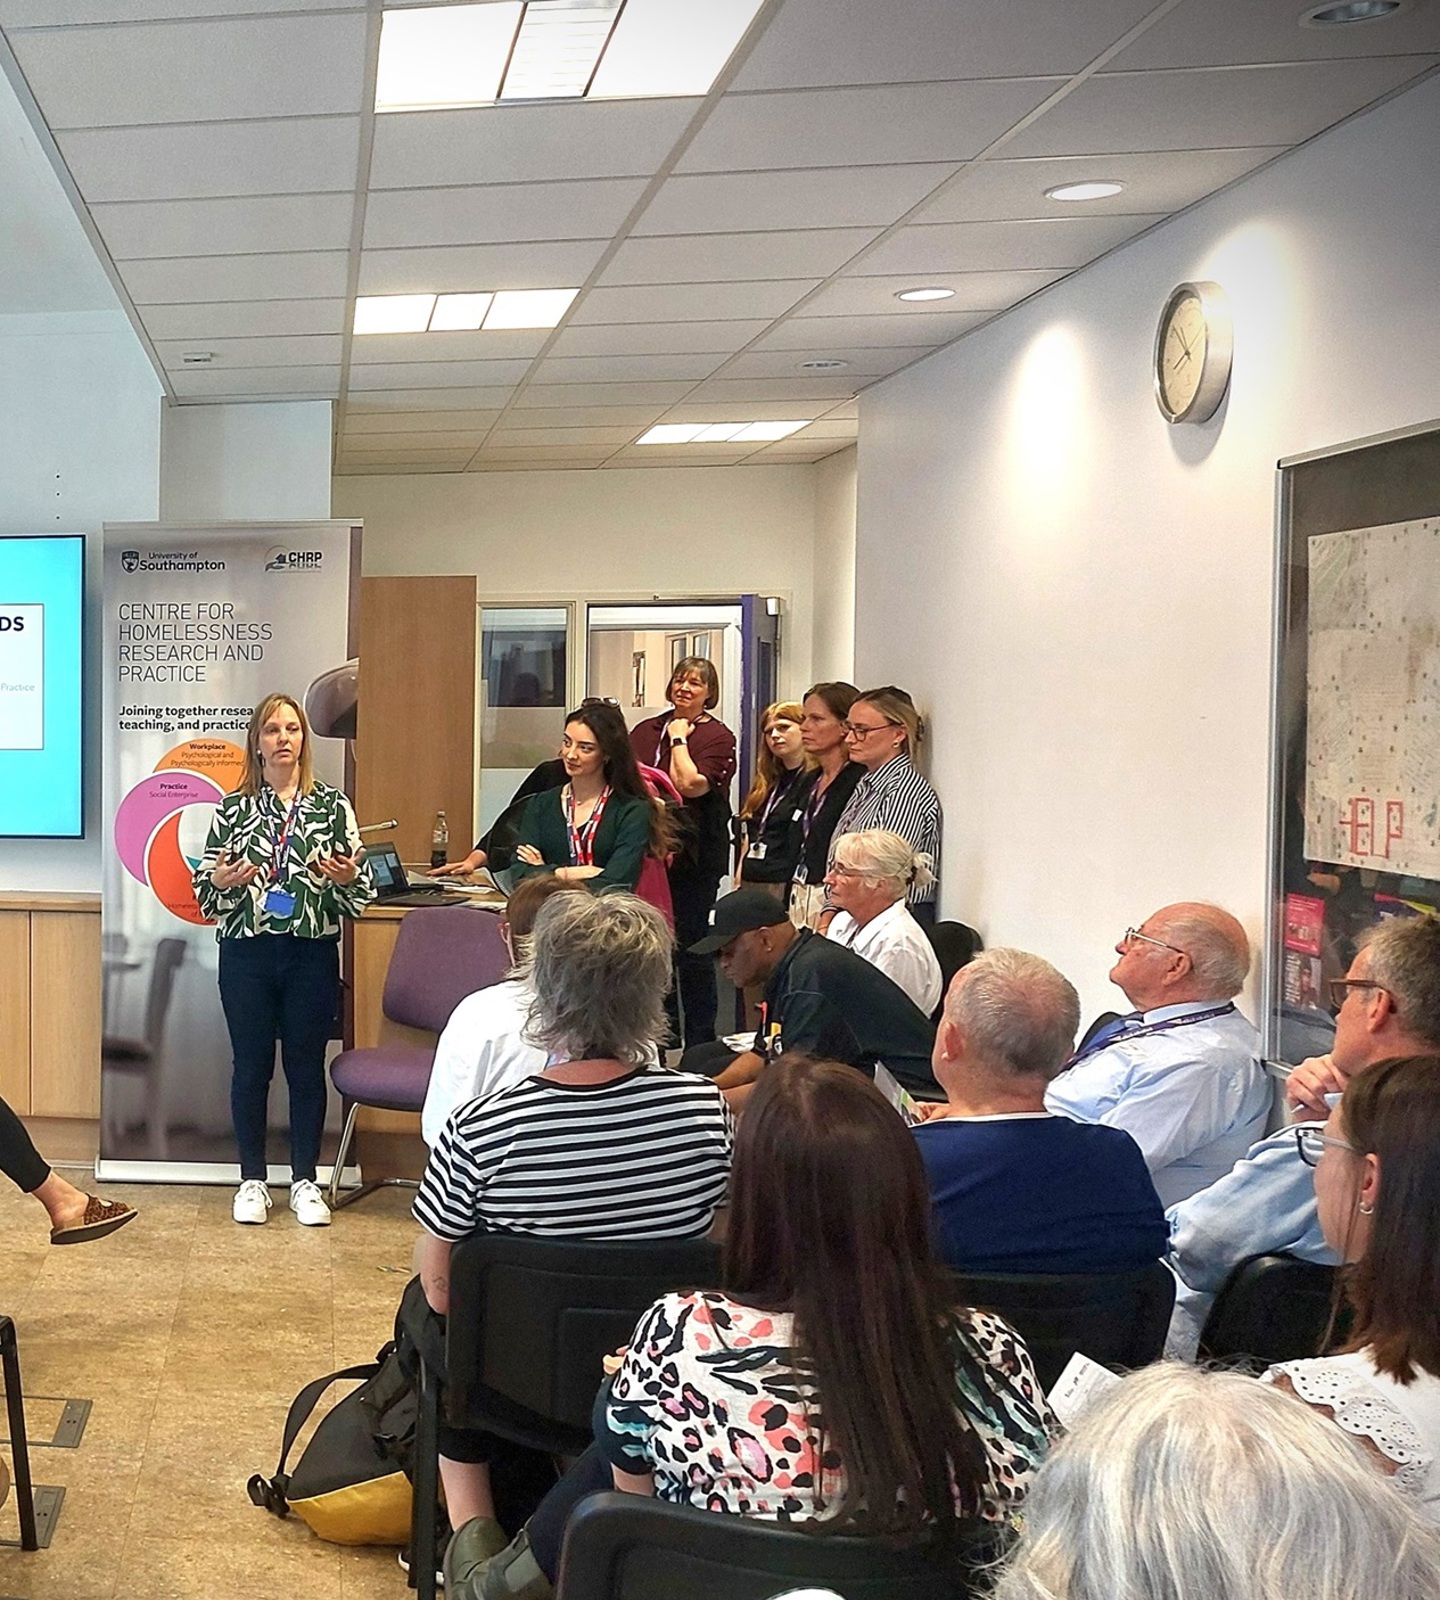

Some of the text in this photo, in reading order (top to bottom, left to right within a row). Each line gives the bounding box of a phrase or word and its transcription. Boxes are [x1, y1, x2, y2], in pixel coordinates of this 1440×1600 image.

[148, 552, 187, 560] University
[288, 552, 322, 563] CHRP
[139, 560, 226, 573] Southampton
[119, 603, 234, 620] CENTRE FOR
[119, 623, 273, 641] HOMELESSNESS
[119, 644, 264, 662] RESEARCH AND
[119, 665, 206, 682] PRACTICE
[1, 682, 35, 692] Practice
[119, 705, 254, 718] Joining together resea
[119, 719, 175, 732] teaching,
[177, 719, 200, 730] and
[189, 743, 226, 751] Workplace
[181, 751, 222, 759] Psychological
[167, 791, 199, 799] Enterprise
